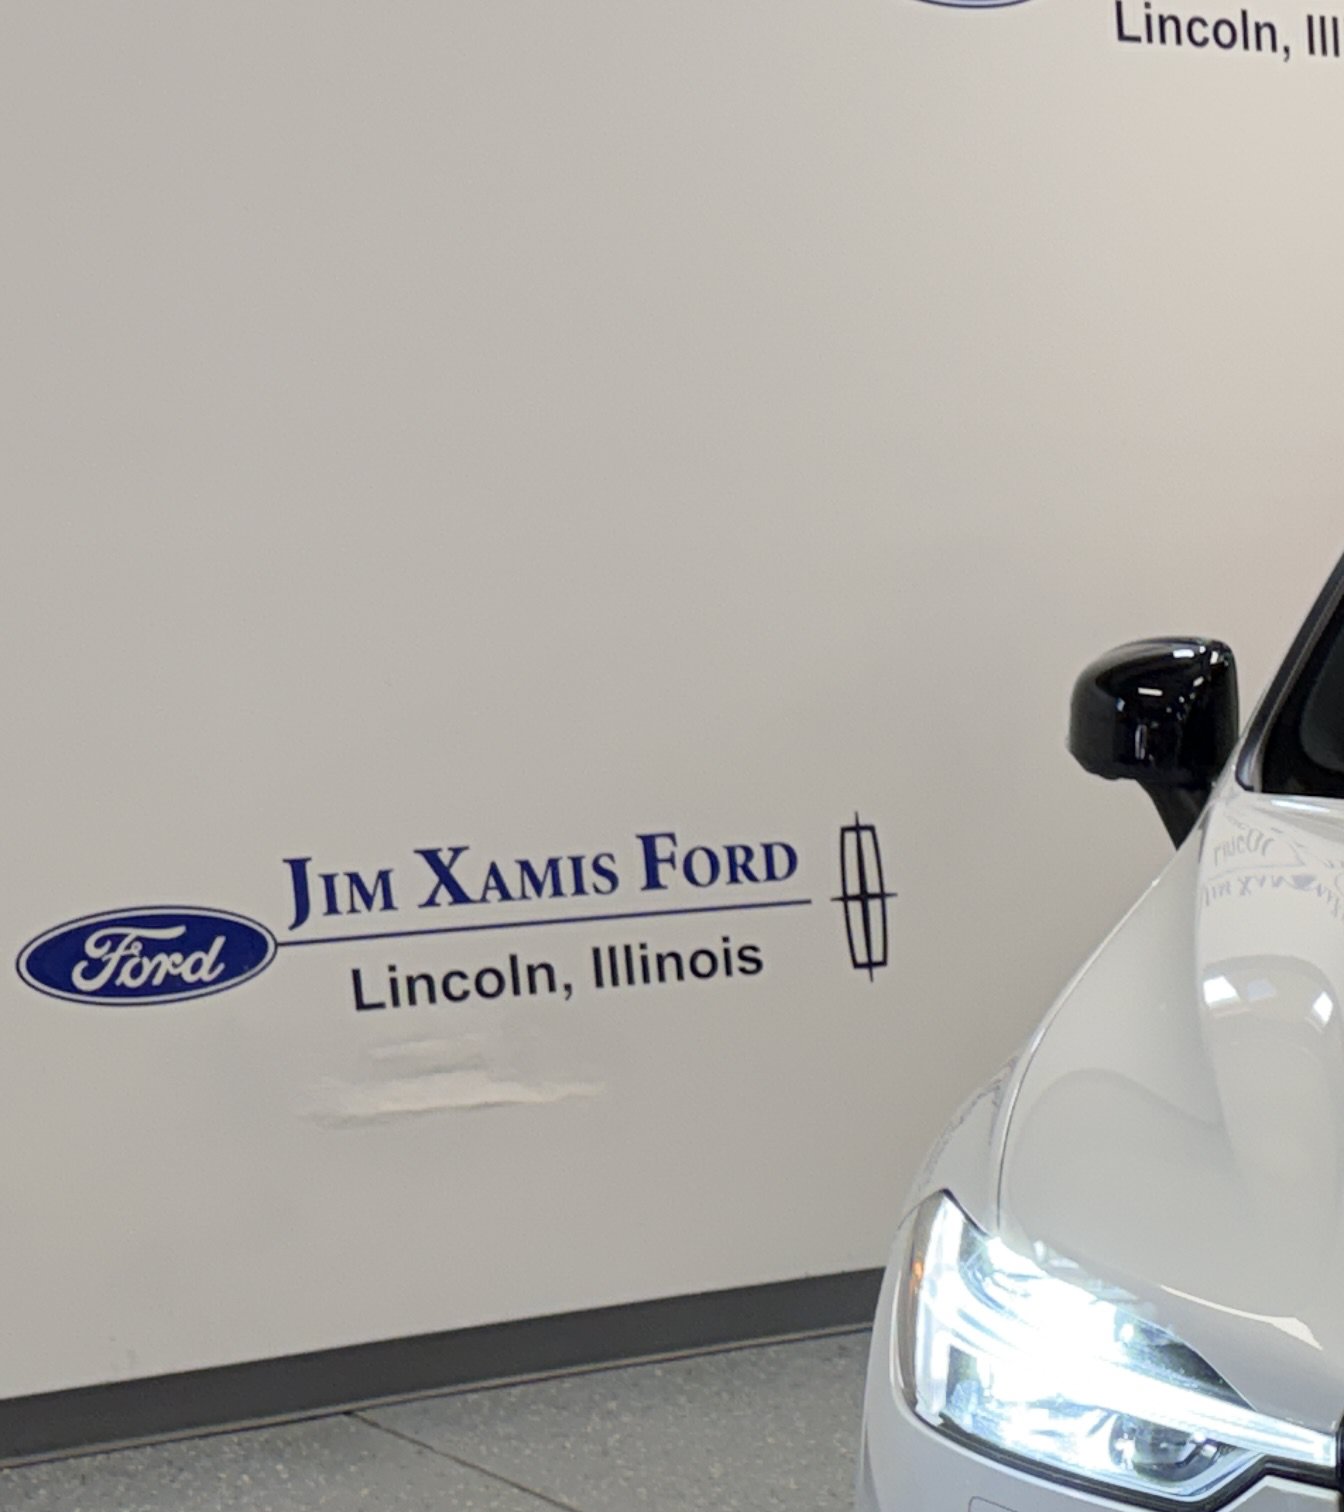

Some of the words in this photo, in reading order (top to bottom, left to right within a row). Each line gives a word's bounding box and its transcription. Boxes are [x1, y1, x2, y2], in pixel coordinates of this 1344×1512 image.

[1114, 0, 1291, 62] Lincoln,
[282, 856, 396, 931] JIM
[413, 845, 620, 909] XAMIS
[635, 831, 799, 891] FORD
[71, 924, 227, 993] Ford
[351, 952, 574, 1012] Lincoln,
[592, 935, 765, 989] Illinois
